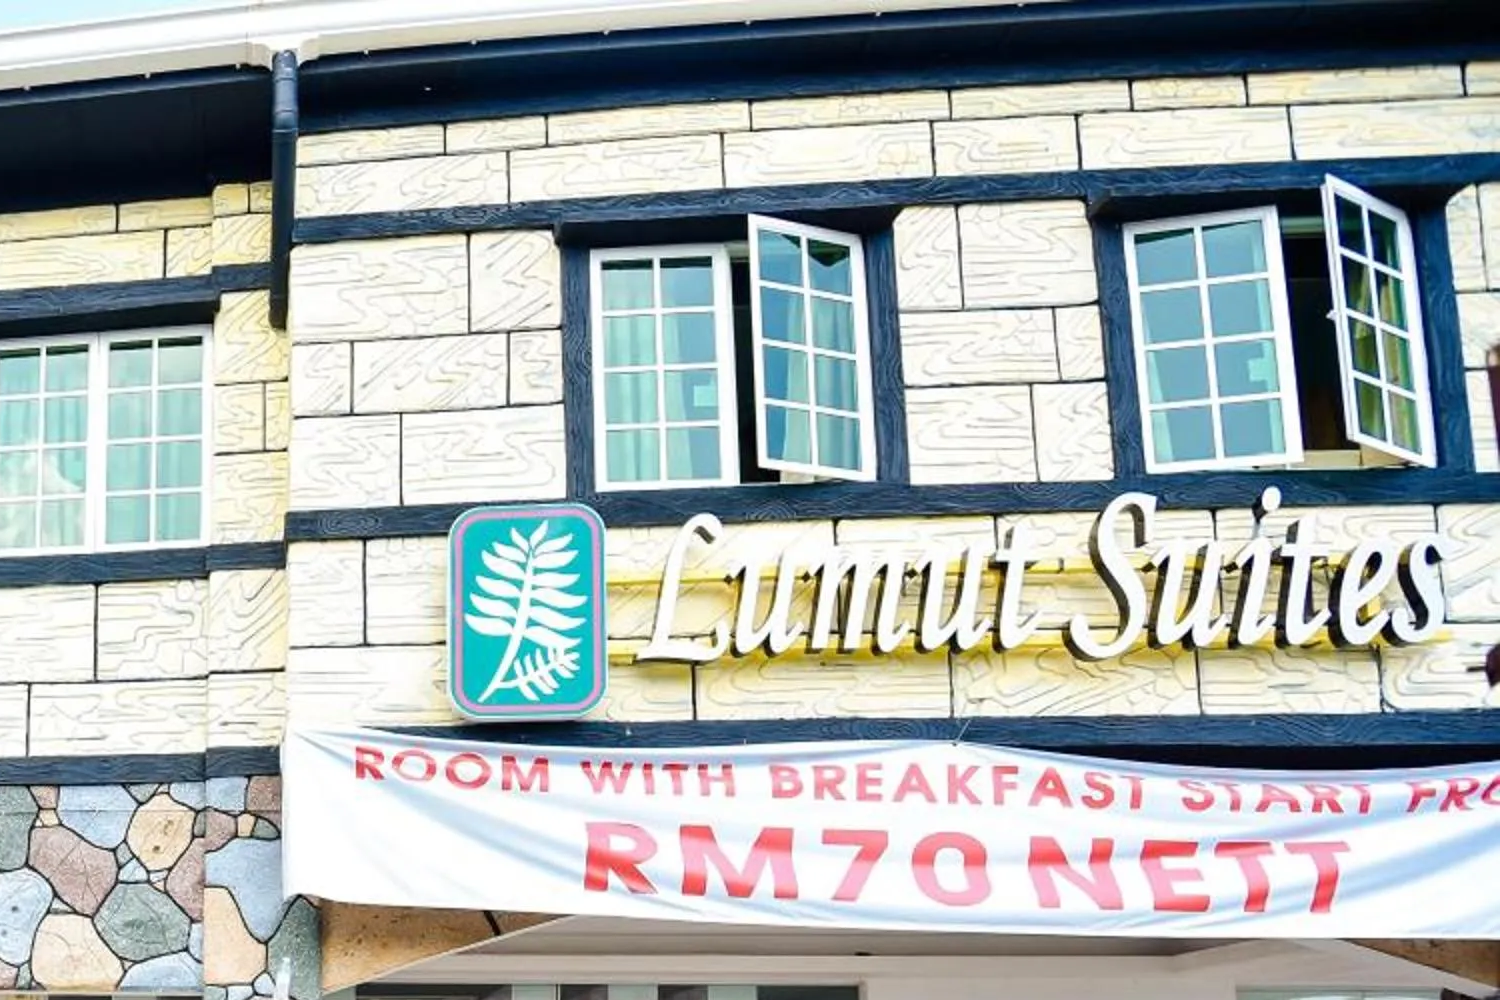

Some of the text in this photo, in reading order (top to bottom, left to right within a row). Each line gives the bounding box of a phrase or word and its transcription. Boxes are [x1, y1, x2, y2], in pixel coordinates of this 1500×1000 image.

[637, 487, 1448, 661] Lumut Suites
[354, 746, 549, 792] ROOM
[581, 760, 734, 798] WITH
[770, 764, 1145, 810] BREAKFAST
[1181, 778, 1371, 813] START
[583, 822, 1352, 913] RM70 NETT
